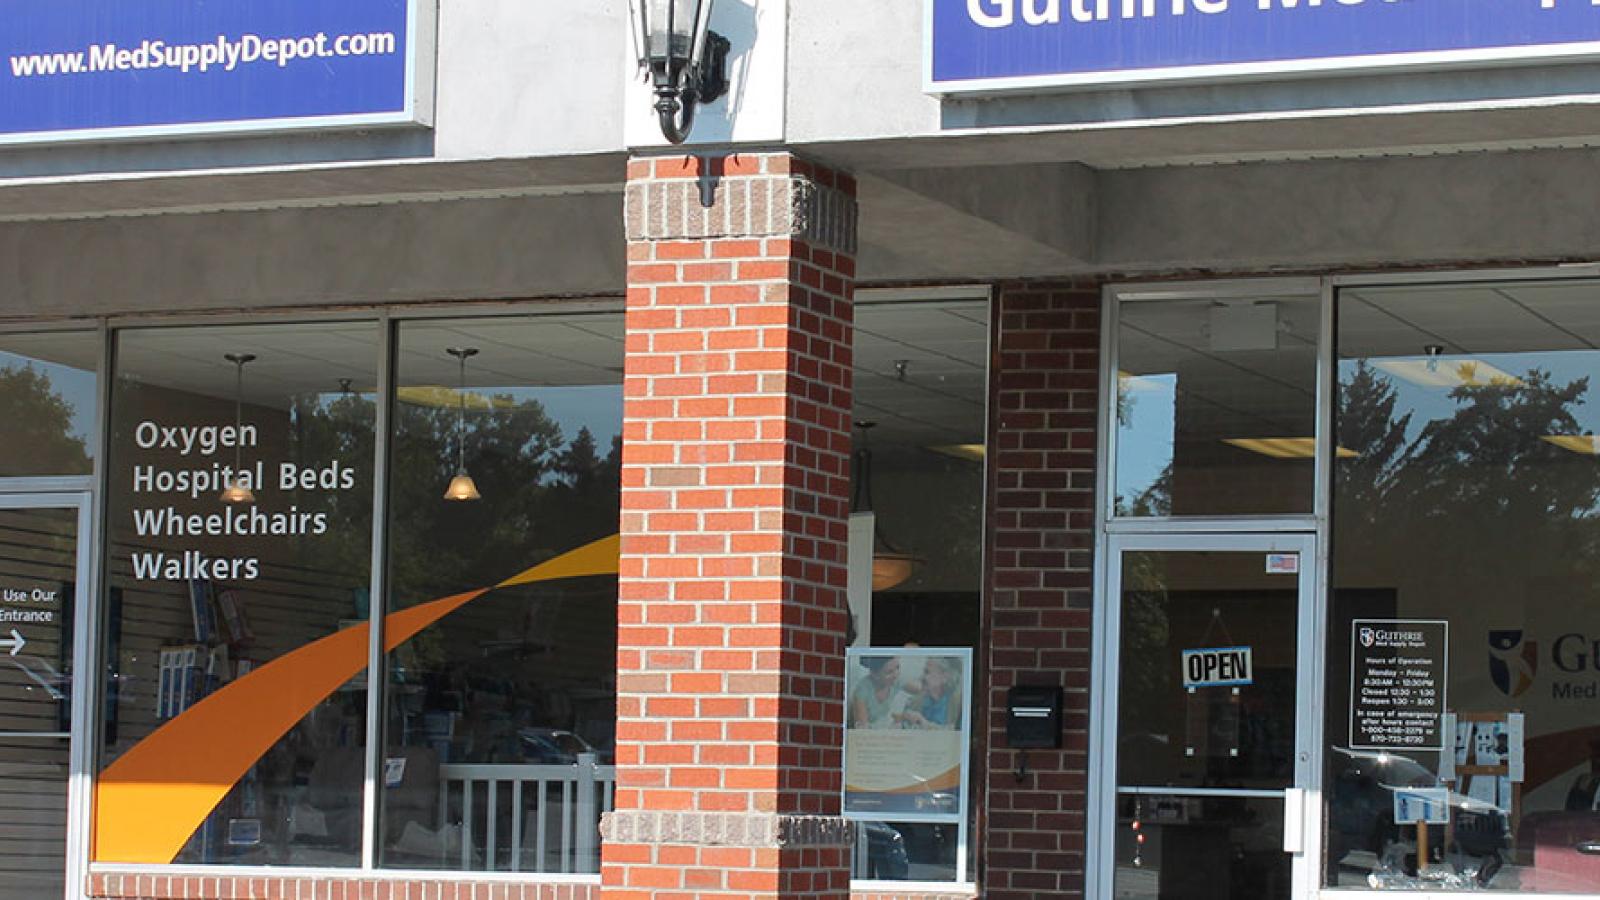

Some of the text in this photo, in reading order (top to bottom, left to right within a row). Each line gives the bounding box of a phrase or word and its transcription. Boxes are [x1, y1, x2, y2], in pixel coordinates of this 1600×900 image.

[10, 31, 395, 76] www.MedSupplyDepot.com
[135, 421, 257, 455] Oxygen
[133, 460, 355, 498] Hospital Beds
[133, 505, 327, 536] Wheelchairs
[131, 550, 260, 580] Walkers
[3, 588, 56, 602] Use Our
[1188, 652, 1247, 682] OPEN
[1365, 656, 1433, 666] Hours of Operation
[1368, 668, 1397, 678] Monday
[1406, 669, 1430, 678] Friday
[1361, 688, 1387, 696] Closed
[1552, 682, 1597, 699] Med
[1397, 711, 1438, 720] emergency
